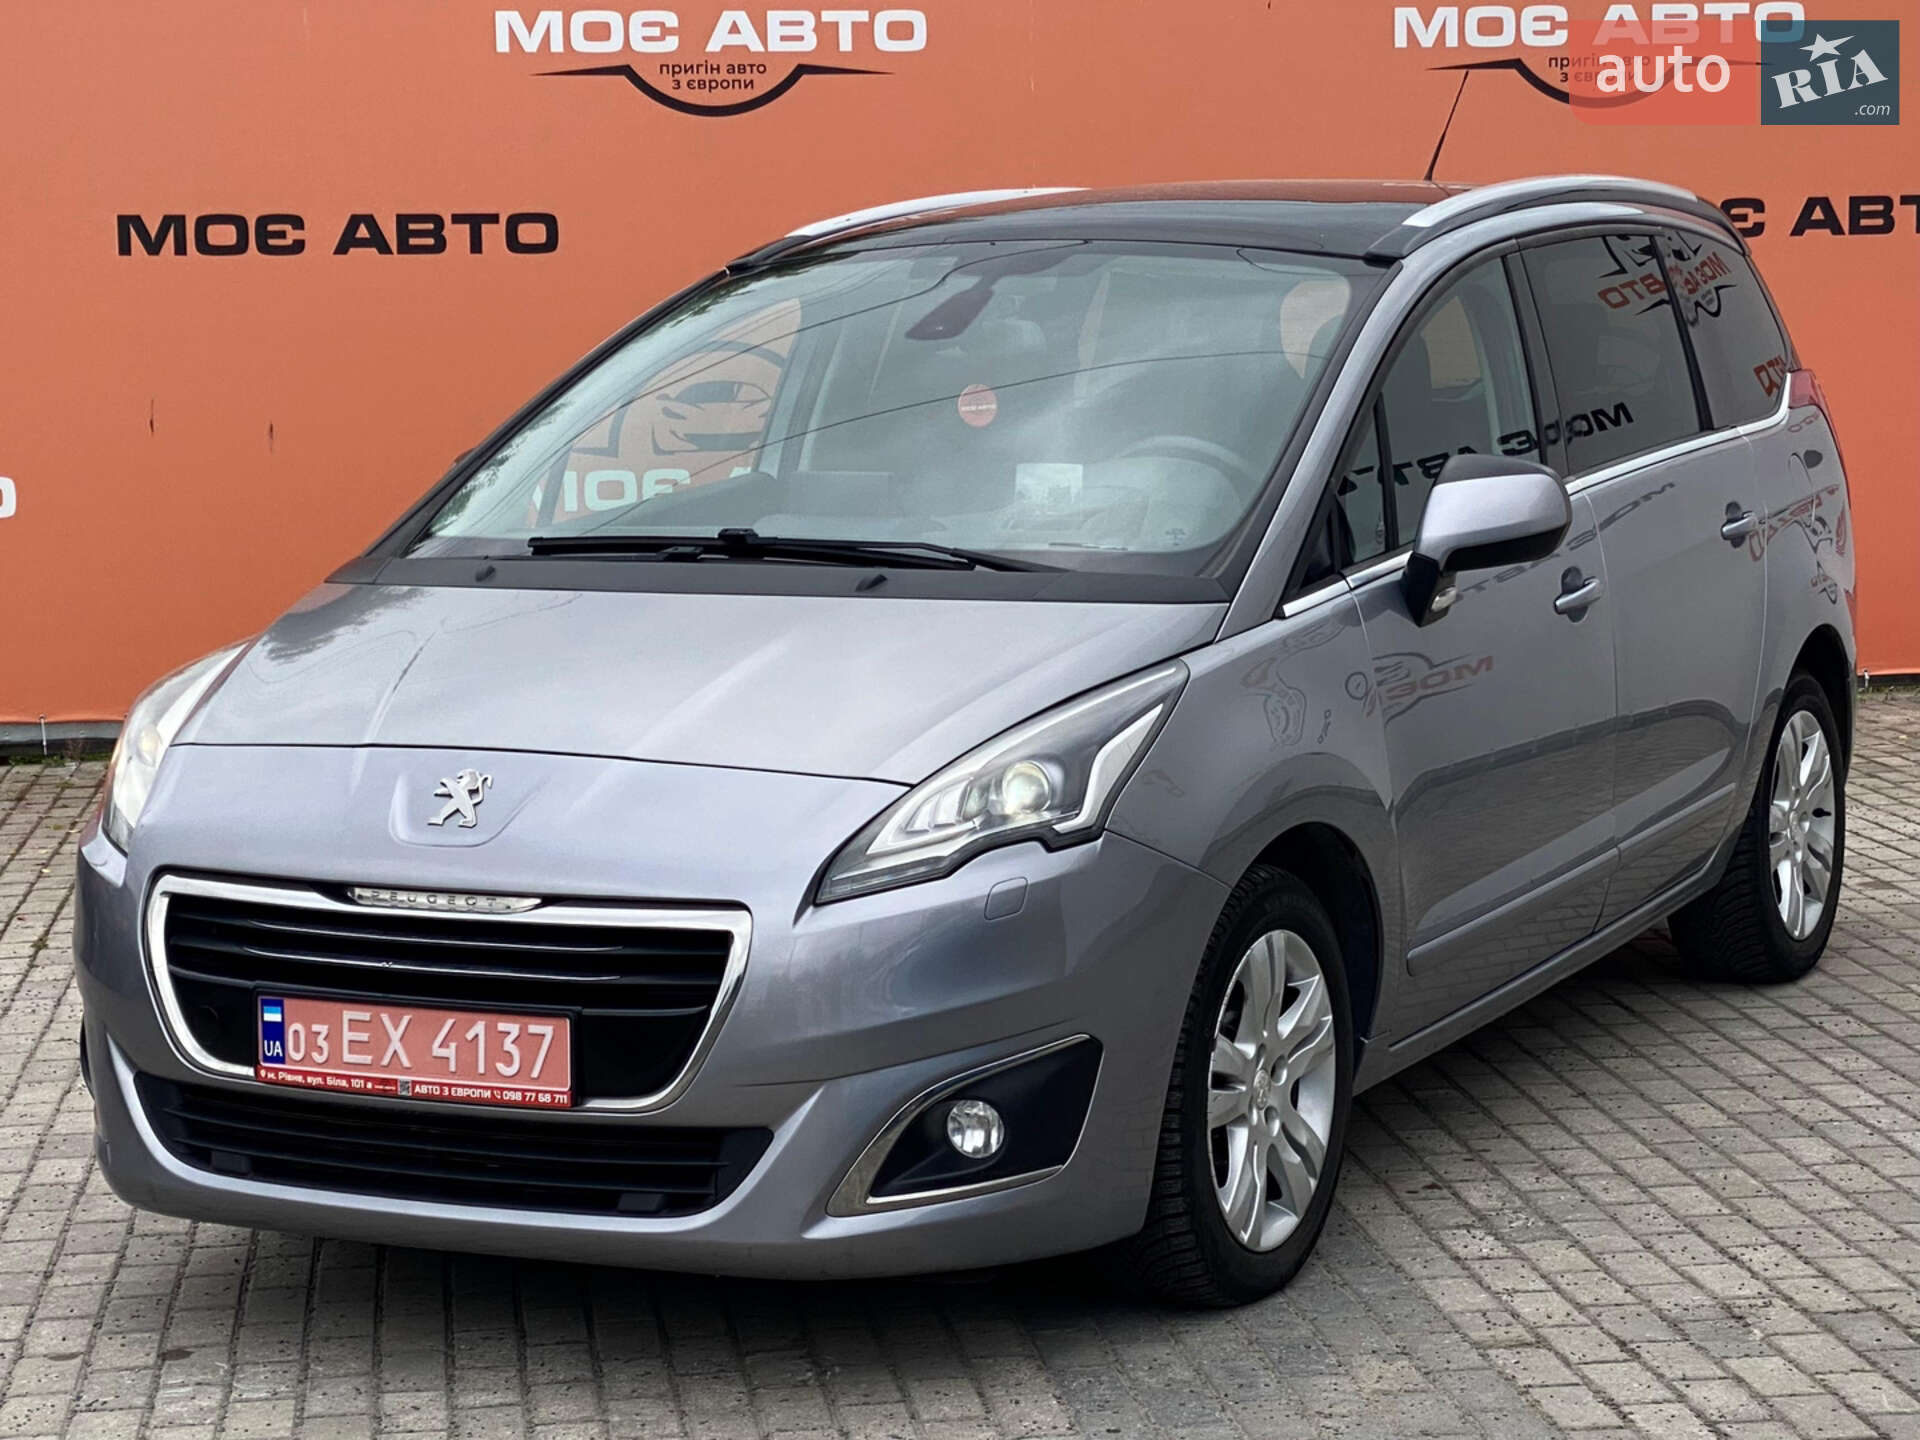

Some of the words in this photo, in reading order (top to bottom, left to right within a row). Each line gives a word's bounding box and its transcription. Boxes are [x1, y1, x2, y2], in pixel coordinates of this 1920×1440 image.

[494, 9, 680, 53] МОЄ
[705, 9, 928, 53] АВТО
[1394, 4, 1569, 48] МОЄ
[1592, 1, 1807, 46] АВТО
[659, 59, 720, 77] пригін
[726, 63, 767, 74] авто
[672, 79, 681, 90] з
[686, 79, 754, 92] європи
[116, 213, 306, 256] МОЄ
[333, 213, 559, 255] АВТО
[264, 1039, 283, 1058] UA
[287, 1022, 329, 1064] 03
[342, 1009, 412, 1069] EX
[431, 1017, 555, 1079] 4137
[414, 1084, 440, 1096] АВТО
[451, 1087, 491, 1099] ЄВРОПИ
[503, 1090, 522, 1101] 098
[524, 1092, 537, 1102] 77
[553, 1094, 568, 1104] 711
